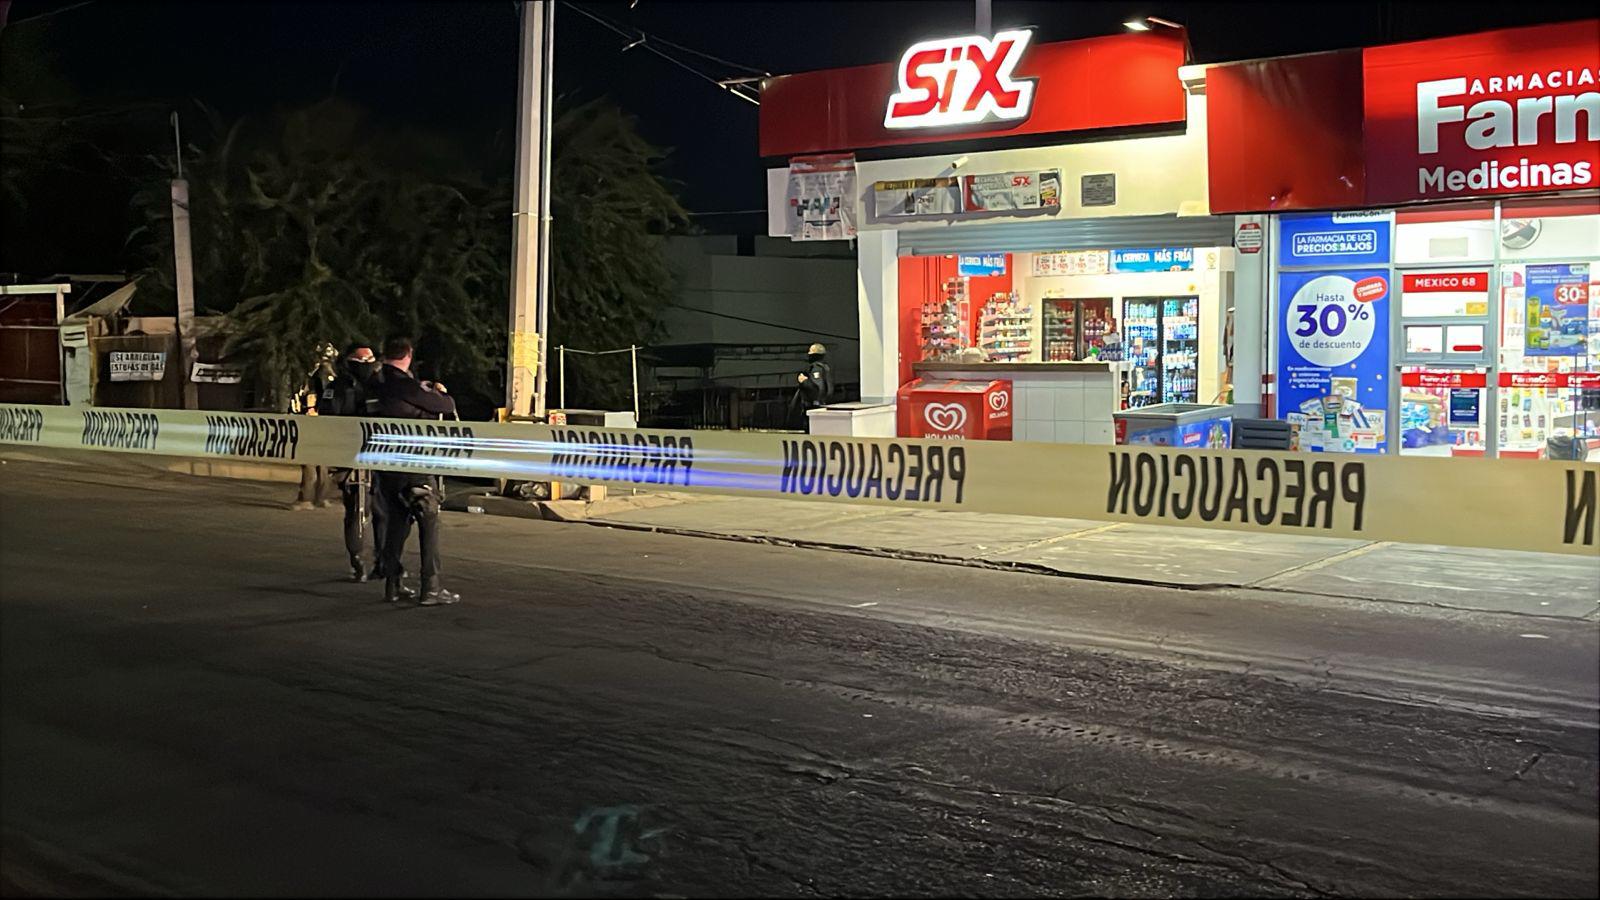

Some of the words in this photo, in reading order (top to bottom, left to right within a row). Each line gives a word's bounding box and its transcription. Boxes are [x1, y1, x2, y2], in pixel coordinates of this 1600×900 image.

[1469, 68, 1600, 95] ARMACIA
[1418, 158, 1591, 194] Medicinas
[1307, 235, 1345, 243] FARMACIA
[1357, 233, 1372, 241] LOS
[1297, 243, 1338, 253] PRECIOS
[1340, 241, 1372, 251] BAJOS
[1461, 277, 1476, 286] 68
[1316, 293, 1345, 302] Hasta
[1295, 303, 1369, 337] 30%
[1299, 340, 1311, 349] de
[1313, 340, 1362, 349] descuento
